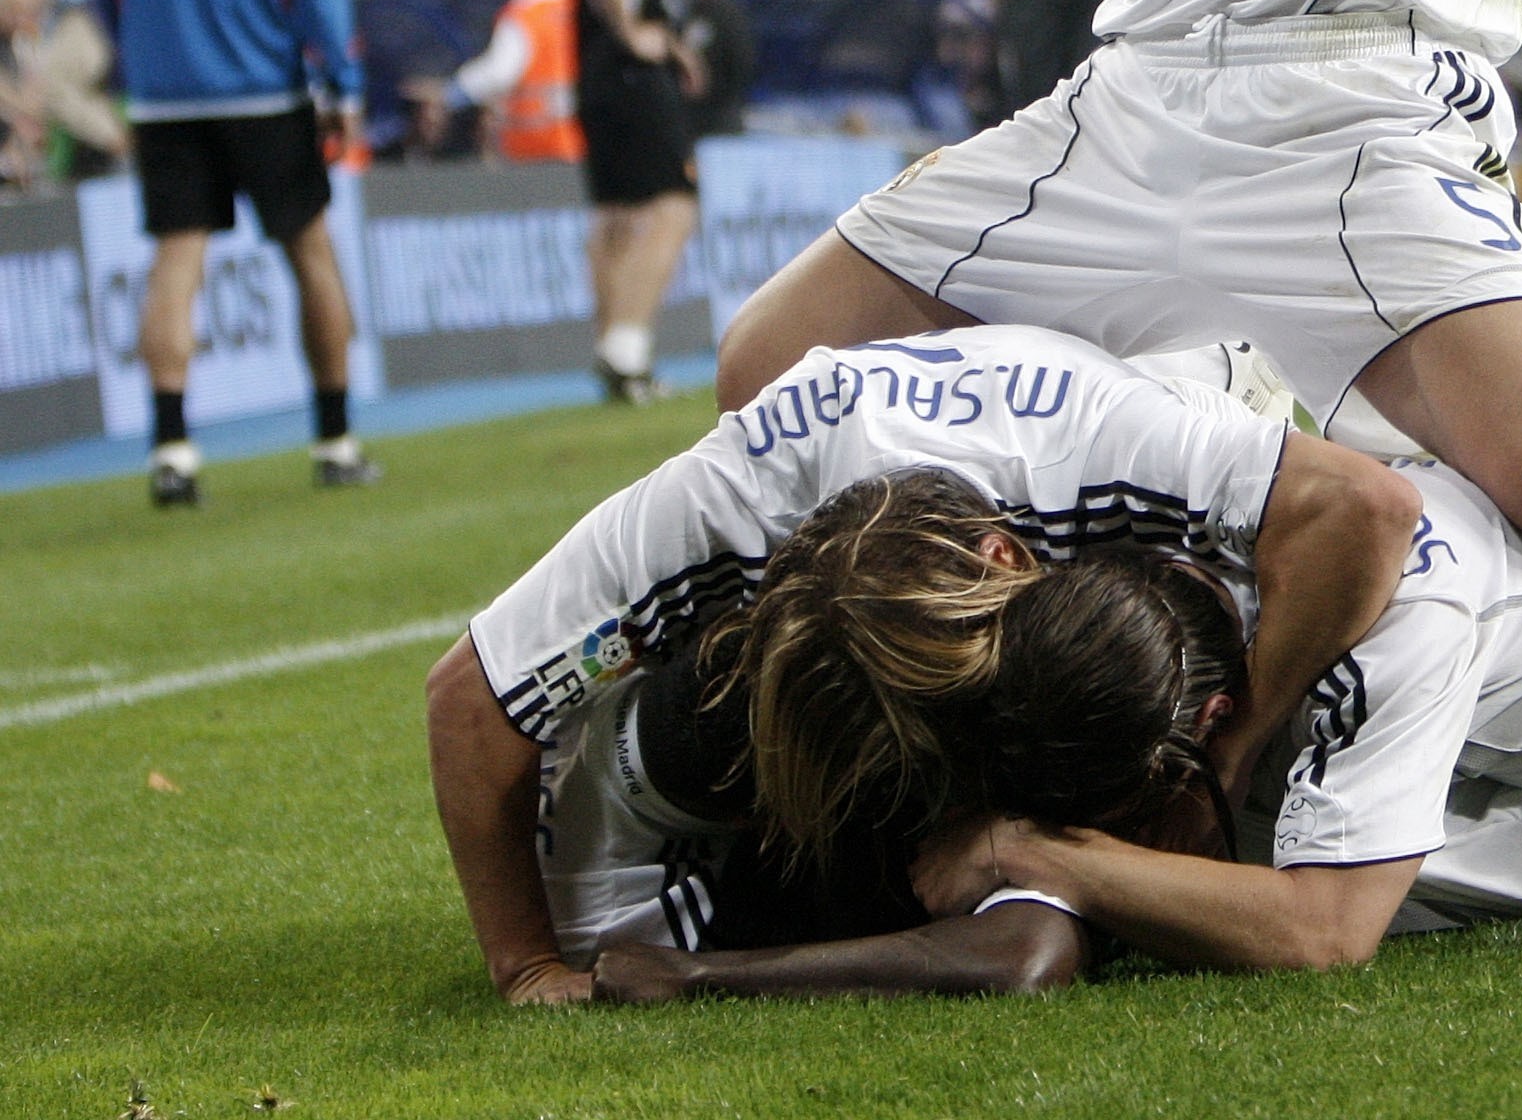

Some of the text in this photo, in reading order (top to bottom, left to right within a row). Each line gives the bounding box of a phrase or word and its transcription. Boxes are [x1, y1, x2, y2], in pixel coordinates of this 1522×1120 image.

[1434, 177, 1521, 251] 5
[535, 651, 586, 708] LFP
[615, 738, 645, 796] Madrid
